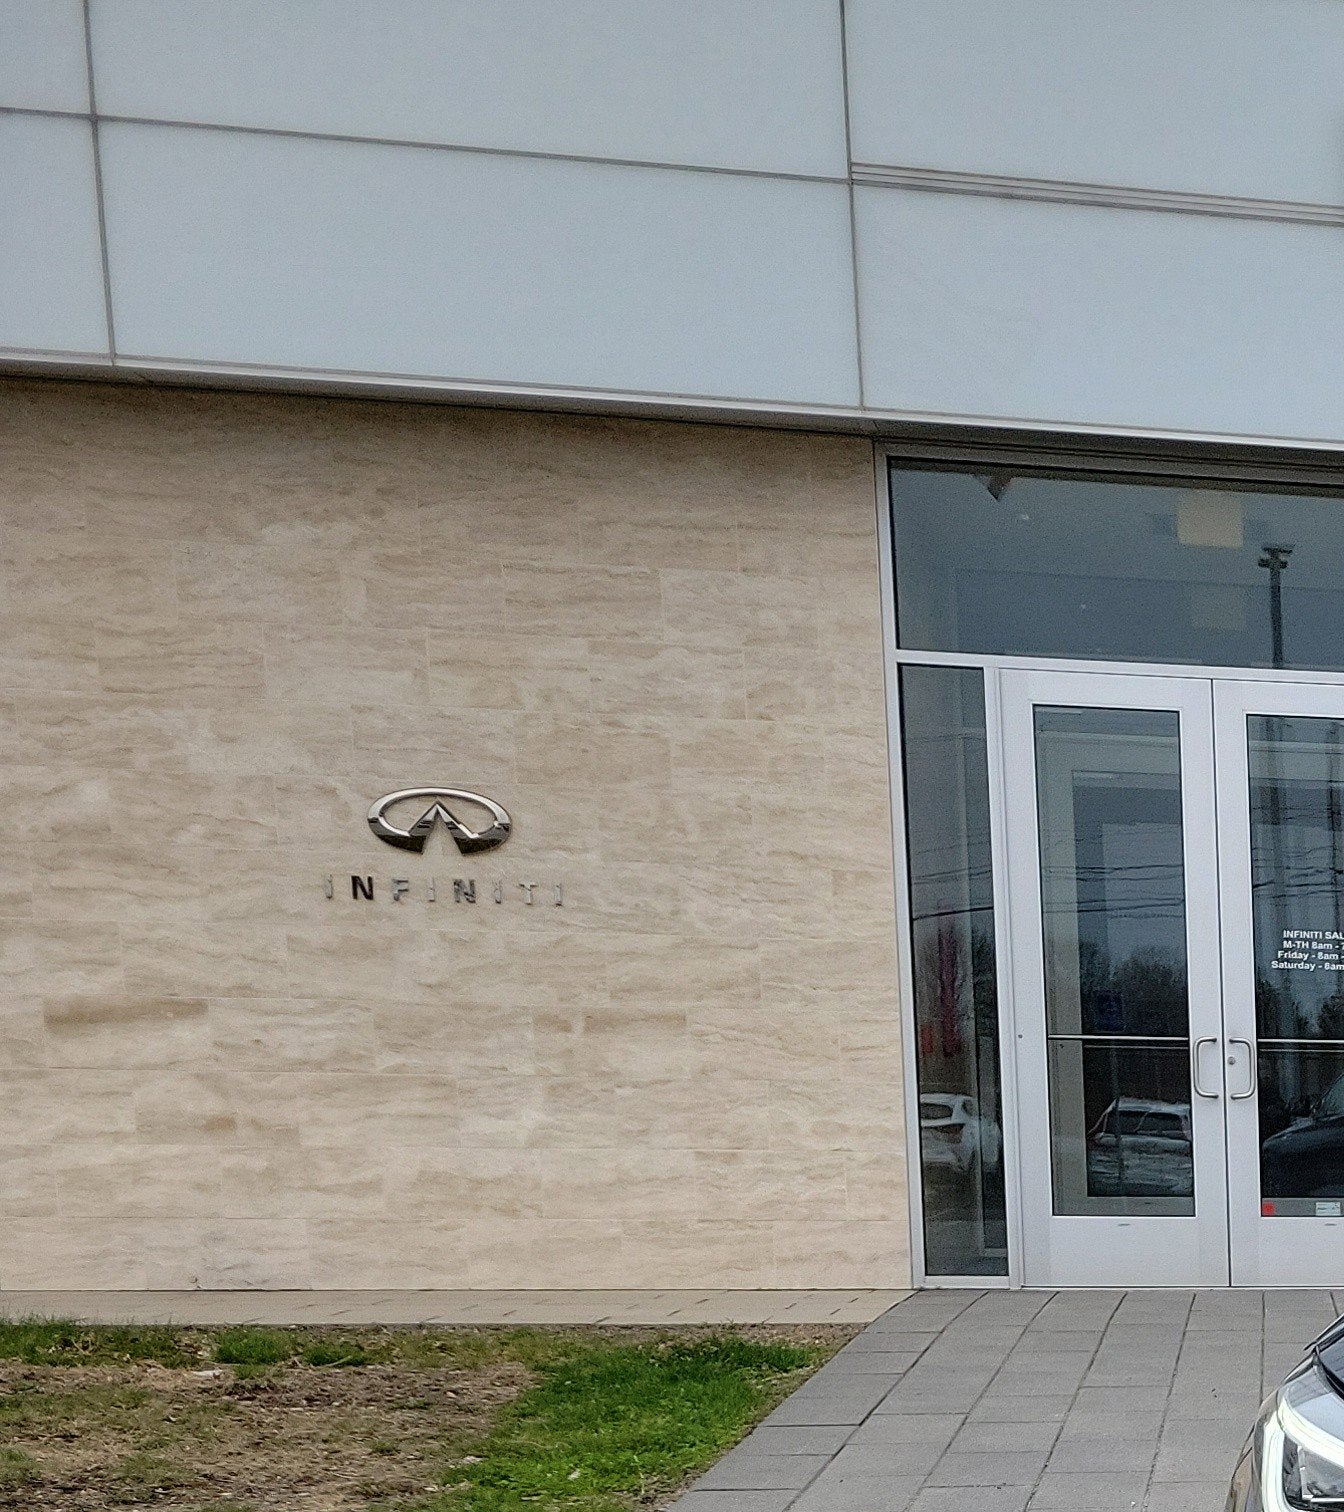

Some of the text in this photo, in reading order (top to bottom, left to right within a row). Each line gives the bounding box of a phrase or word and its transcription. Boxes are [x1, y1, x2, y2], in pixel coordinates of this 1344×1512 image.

[324, 873, 563, 907] INFINITI
[1283, 930, 1322, 939] INFINITI
[1283, 941, 1309, 949] M-TH
[1277, 951, 1309, 960] Friday
[1271, 961, 1316, 971] Saturday
